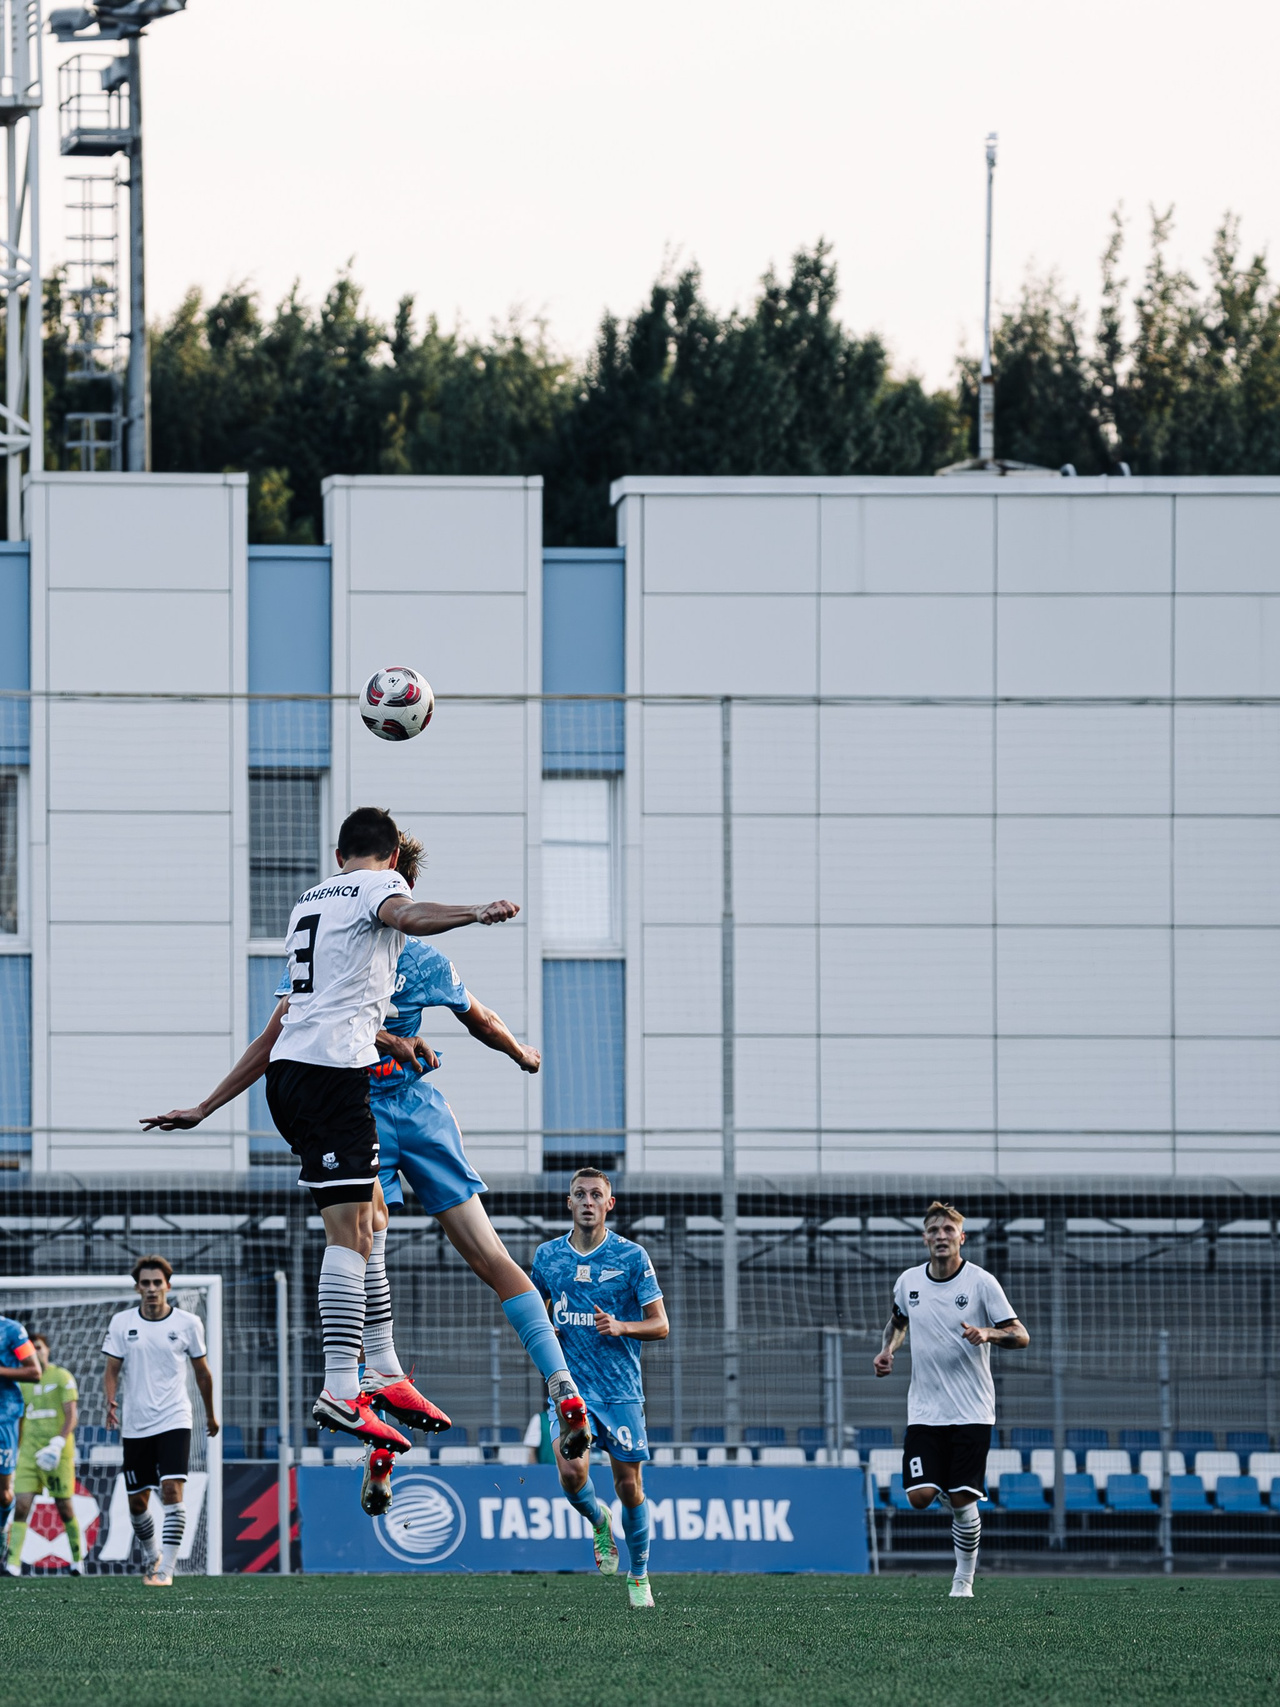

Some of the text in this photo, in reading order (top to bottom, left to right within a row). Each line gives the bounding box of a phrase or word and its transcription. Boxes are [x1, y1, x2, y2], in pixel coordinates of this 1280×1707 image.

[292, 913, 321, 993] 3
[126, 1470, 137, 1485] 11
[909, 1456, 924, 1478] 8
[479, 1497, 794, 1541] ГАЗПМБАНК
